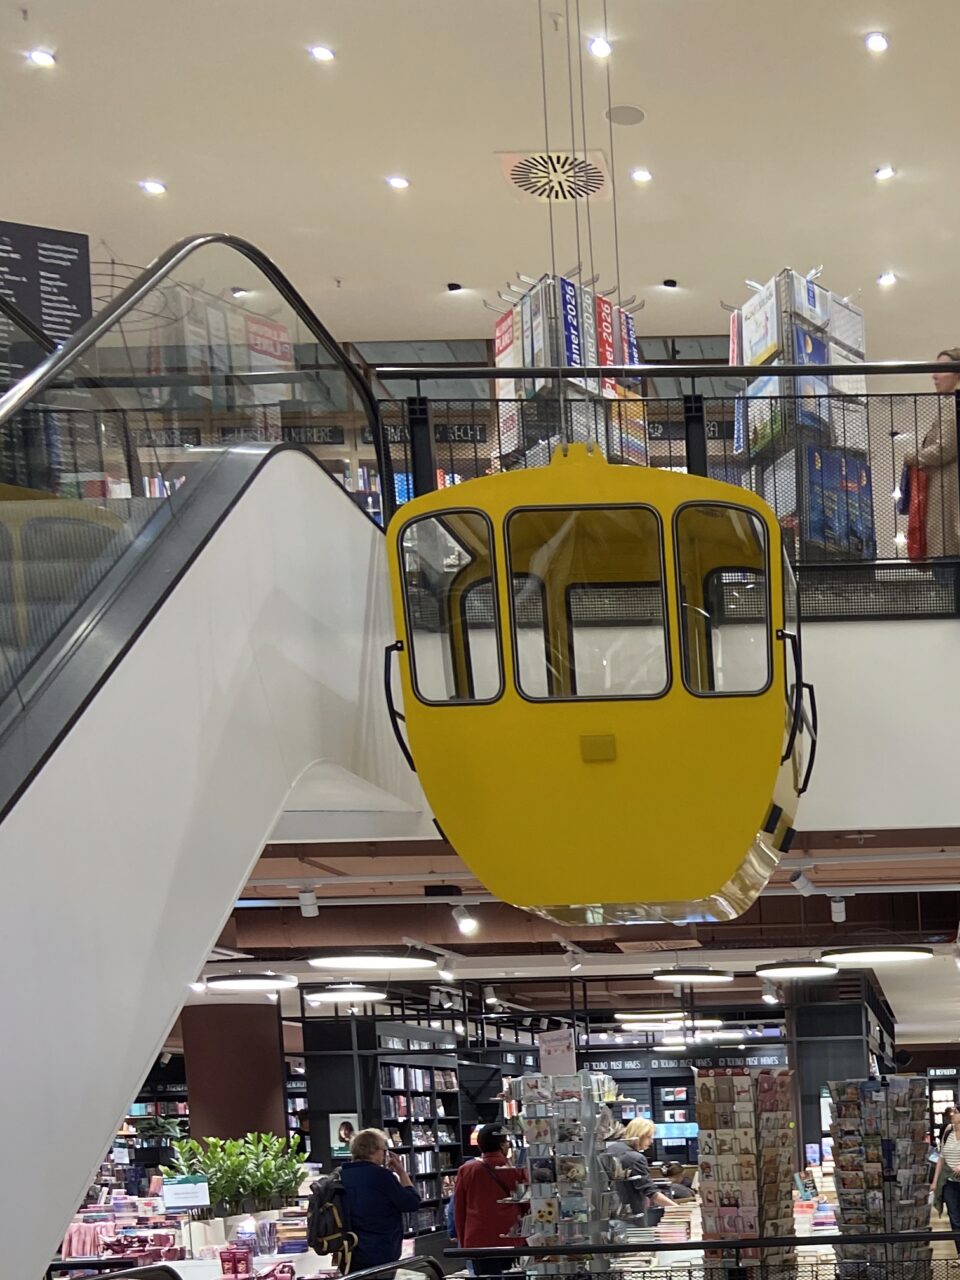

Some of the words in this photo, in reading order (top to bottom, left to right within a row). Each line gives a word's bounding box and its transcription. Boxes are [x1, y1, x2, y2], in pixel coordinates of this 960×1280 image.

[566, 284, 579, 326] 2026
[583, 294, 594, 334] 2026
[601, 302, 613, 339] 2026
